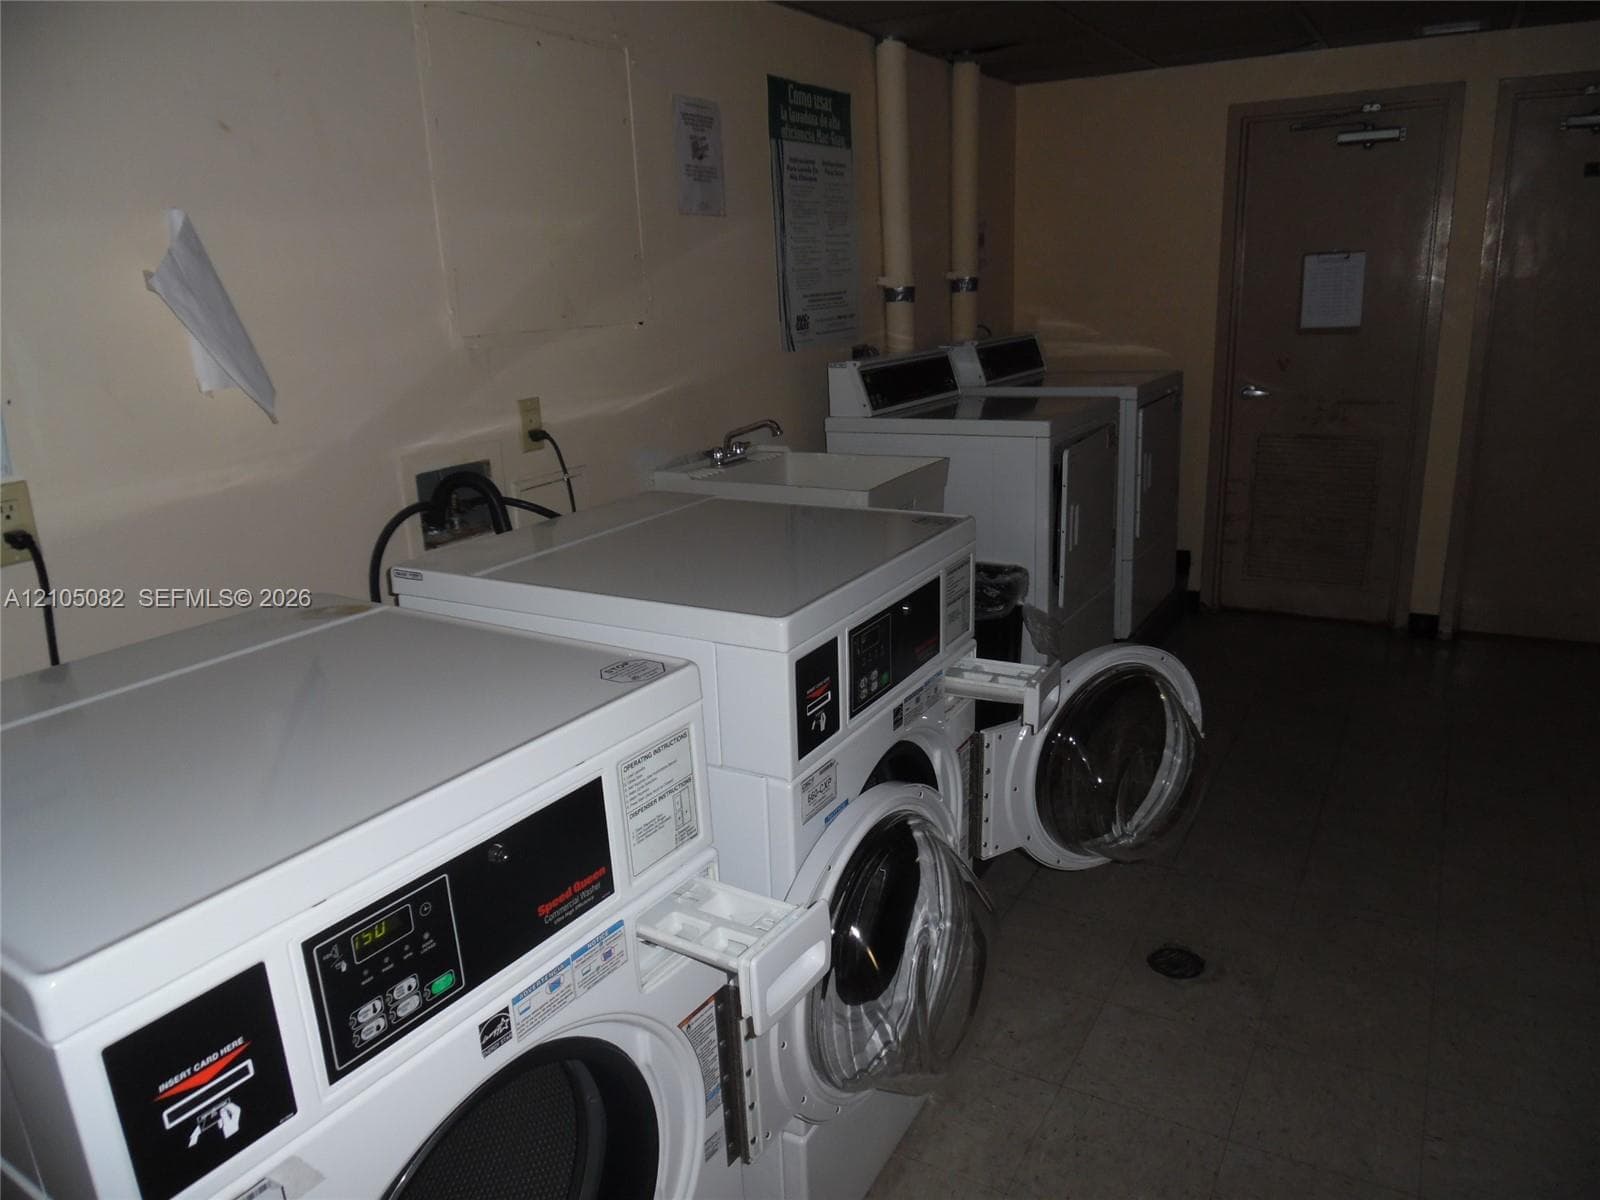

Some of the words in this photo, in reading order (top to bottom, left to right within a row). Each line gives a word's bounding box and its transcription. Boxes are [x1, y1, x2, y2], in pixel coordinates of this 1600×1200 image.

[623, 751, 653, 773] OPERATING
[653, 731, 688, 756] INSTRUCTIONS
[629, 798, 658, 820] DISPENSER
[658, 776, 692, 802] INSTRUCTIONS
[538, 886, 573, 917] Speed
[573, 866, 607, 894] Queen
[543, 895, 580, 925] Commercial
[580, 881, 601, 900] Washer
[586, 930, 609, 950] NOTICE
[518, 961, 567, 1001] ADVERTENCIA
[158, 1066, 193, 1094] INSERT
[193, 1051, 220, 1073] CARD
[219, 1036, 245, 1057] HERE
